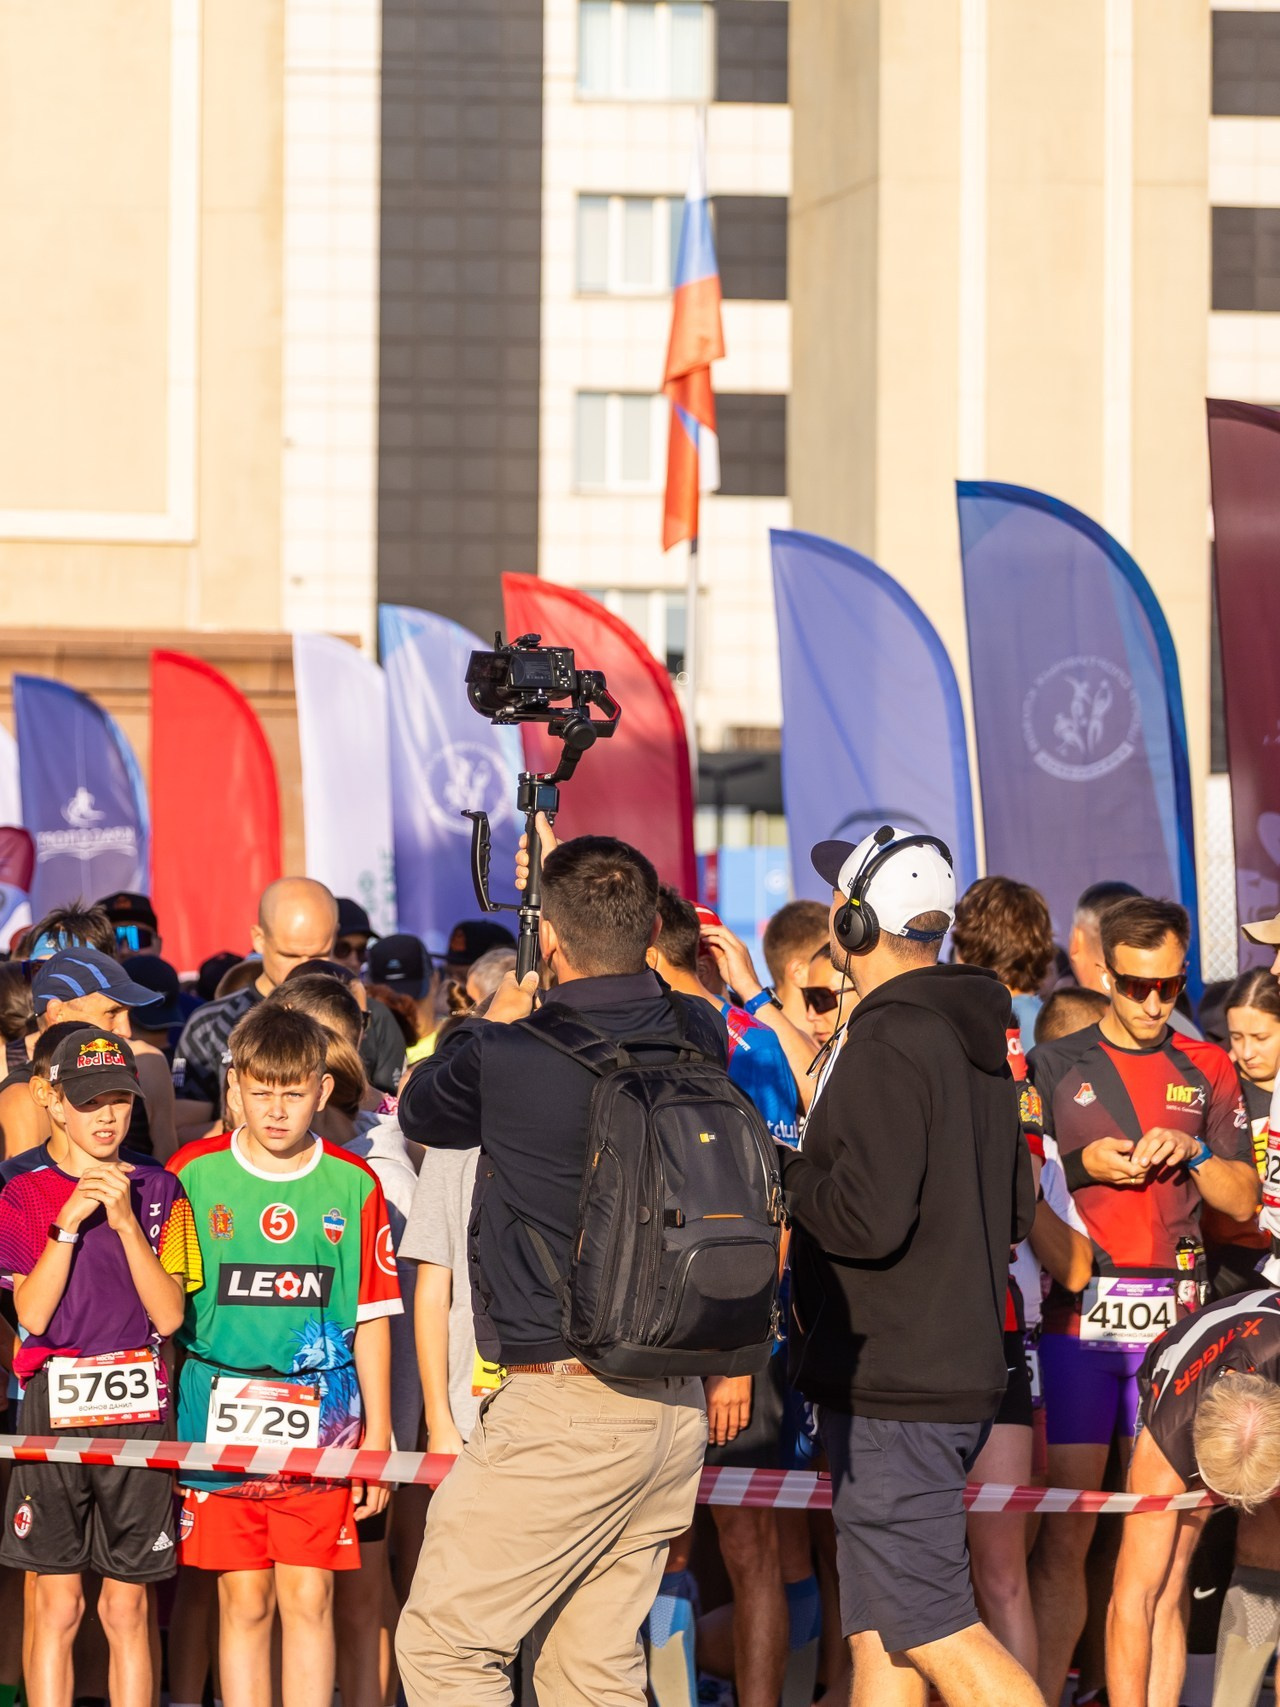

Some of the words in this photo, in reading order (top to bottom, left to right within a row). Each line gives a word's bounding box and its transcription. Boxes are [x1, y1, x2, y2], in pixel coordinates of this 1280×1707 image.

[77, 1052, 102, 1068] Red
[102, 1052, 126, 1067] Bull
[227, 1270, 324, 1300] LEON
[1087, 1301, 1171, 1331] 4104
[1173, 1317, 1264, 1396] X-TIGER
[58, 1368, 149, 1404] 5763
[108, 1402, 133, 1410] ДАНИЛ
[216, 1403, 310, 1439] 5729
